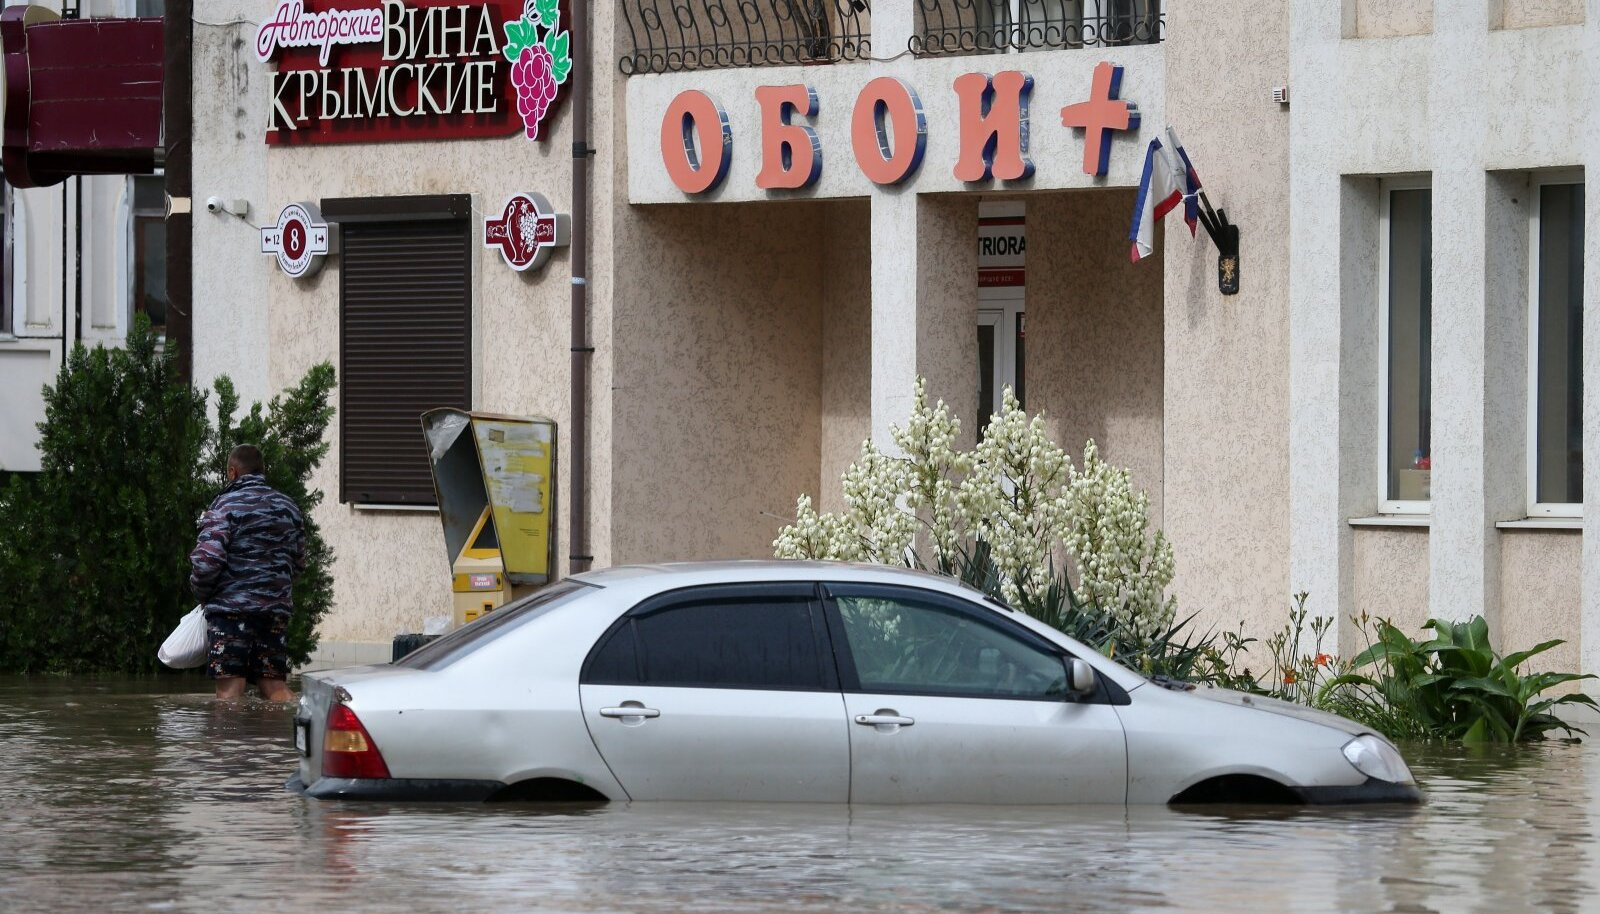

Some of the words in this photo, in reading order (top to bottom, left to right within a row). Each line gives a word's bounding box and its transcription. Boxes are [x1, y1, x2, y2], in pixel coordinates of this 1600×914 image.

[257, 2, 381, 59] Авторские
[381, 0, 500, 61] ВИНА
[266, 61, 497, 131] КРЫМСКИЕ
[273, 234, 280, 245] 12
[290, 228, 299, 251] 8
